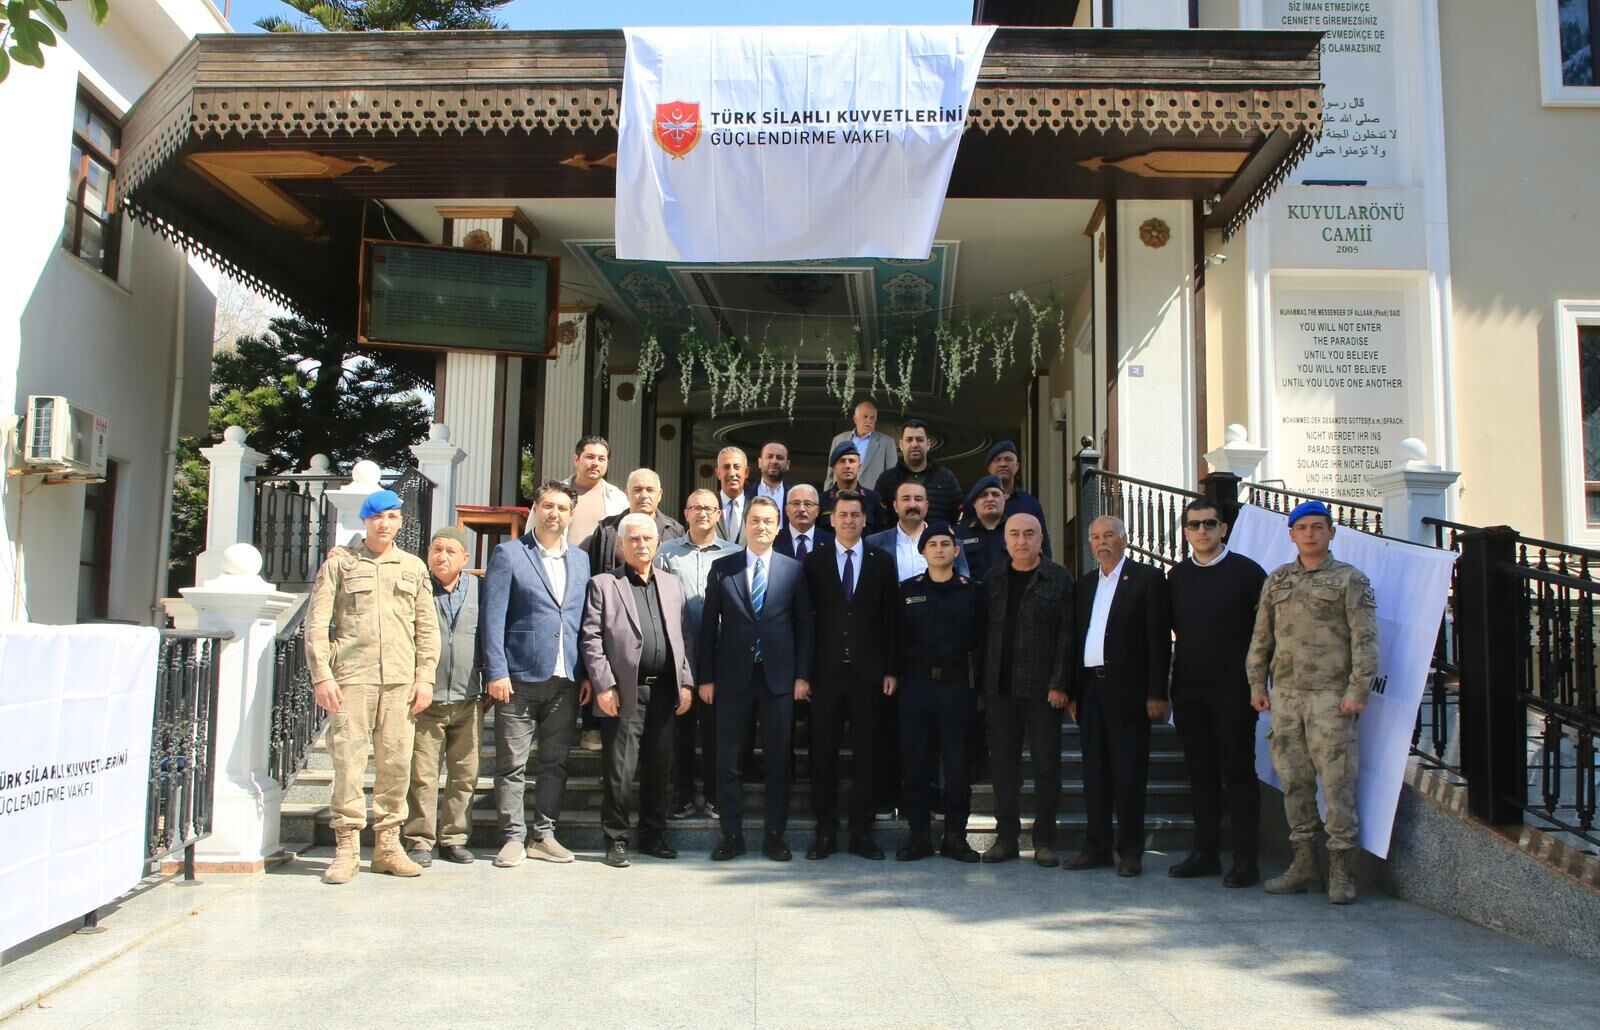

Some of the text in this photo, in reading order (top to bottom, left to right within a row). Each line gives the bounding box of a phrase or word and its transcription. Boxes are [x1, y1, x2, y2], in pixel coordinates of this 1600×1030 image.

[1289, 1, 1370, 13] SİZ İMAN ETMEDİKÇE
[1282, 14, 1378, 25] CENNET'E GİREMEZSİNİZ
[1375, 31, 1385, 39] DE
[1329, 44, 1381, 53] OLAMAZSINIZ
[1349, 97, 1364, 108] قال
[711, 104, 963, 124] TÜRK SİLAHLI KUVVETLERİNİ
[1323, 113, 1380, 125] صلى الله علي
[711, 128, 890, 147] GÜÇLENDİRME VAKFI
[1326, 129, 1349, 140] الجنة
[1352, 130, 1386, 141] تدخلون
[1389, 130, 1396, 139] لا
[1288, 203, 1405, 221] KUYULARÖNÜ
[1322, 224, 1373, 242] CAMİİ
[1336, 246, 1359, 254] 2005
[1299, 323, 1381, 332] YOU WILL NOT ENTER
[1314, 337, 1368, 346] THE PARADISE
[1304, 351, 1378, 360] UNTIL YOU BELIEVE
[1297, 365, 1387, 374] YOU WILL NOT BELIEVE
[1282, 379, 1402, 388] UNTIL YOU LOVE ONE ANOTHER
[1306, 432, 1381, 441] NICHT WERDET IHR INS
[1307, 446, 1340, 455] PARADIES
[1298, 460, 1392, 469] SOLANGE IHR NICHT GLAUBT
[1306, 474, 1319, 483] UND
[1322, 474, 1332, 483] IHR
[1335, 474, 1361, 483] GLAUBT
[1366, 488, 1382, 497] NICH
[0, 770, 22, 790] ÜRK
[0, 781, 93, 816] ÜÇLENDİRME VAKFI
